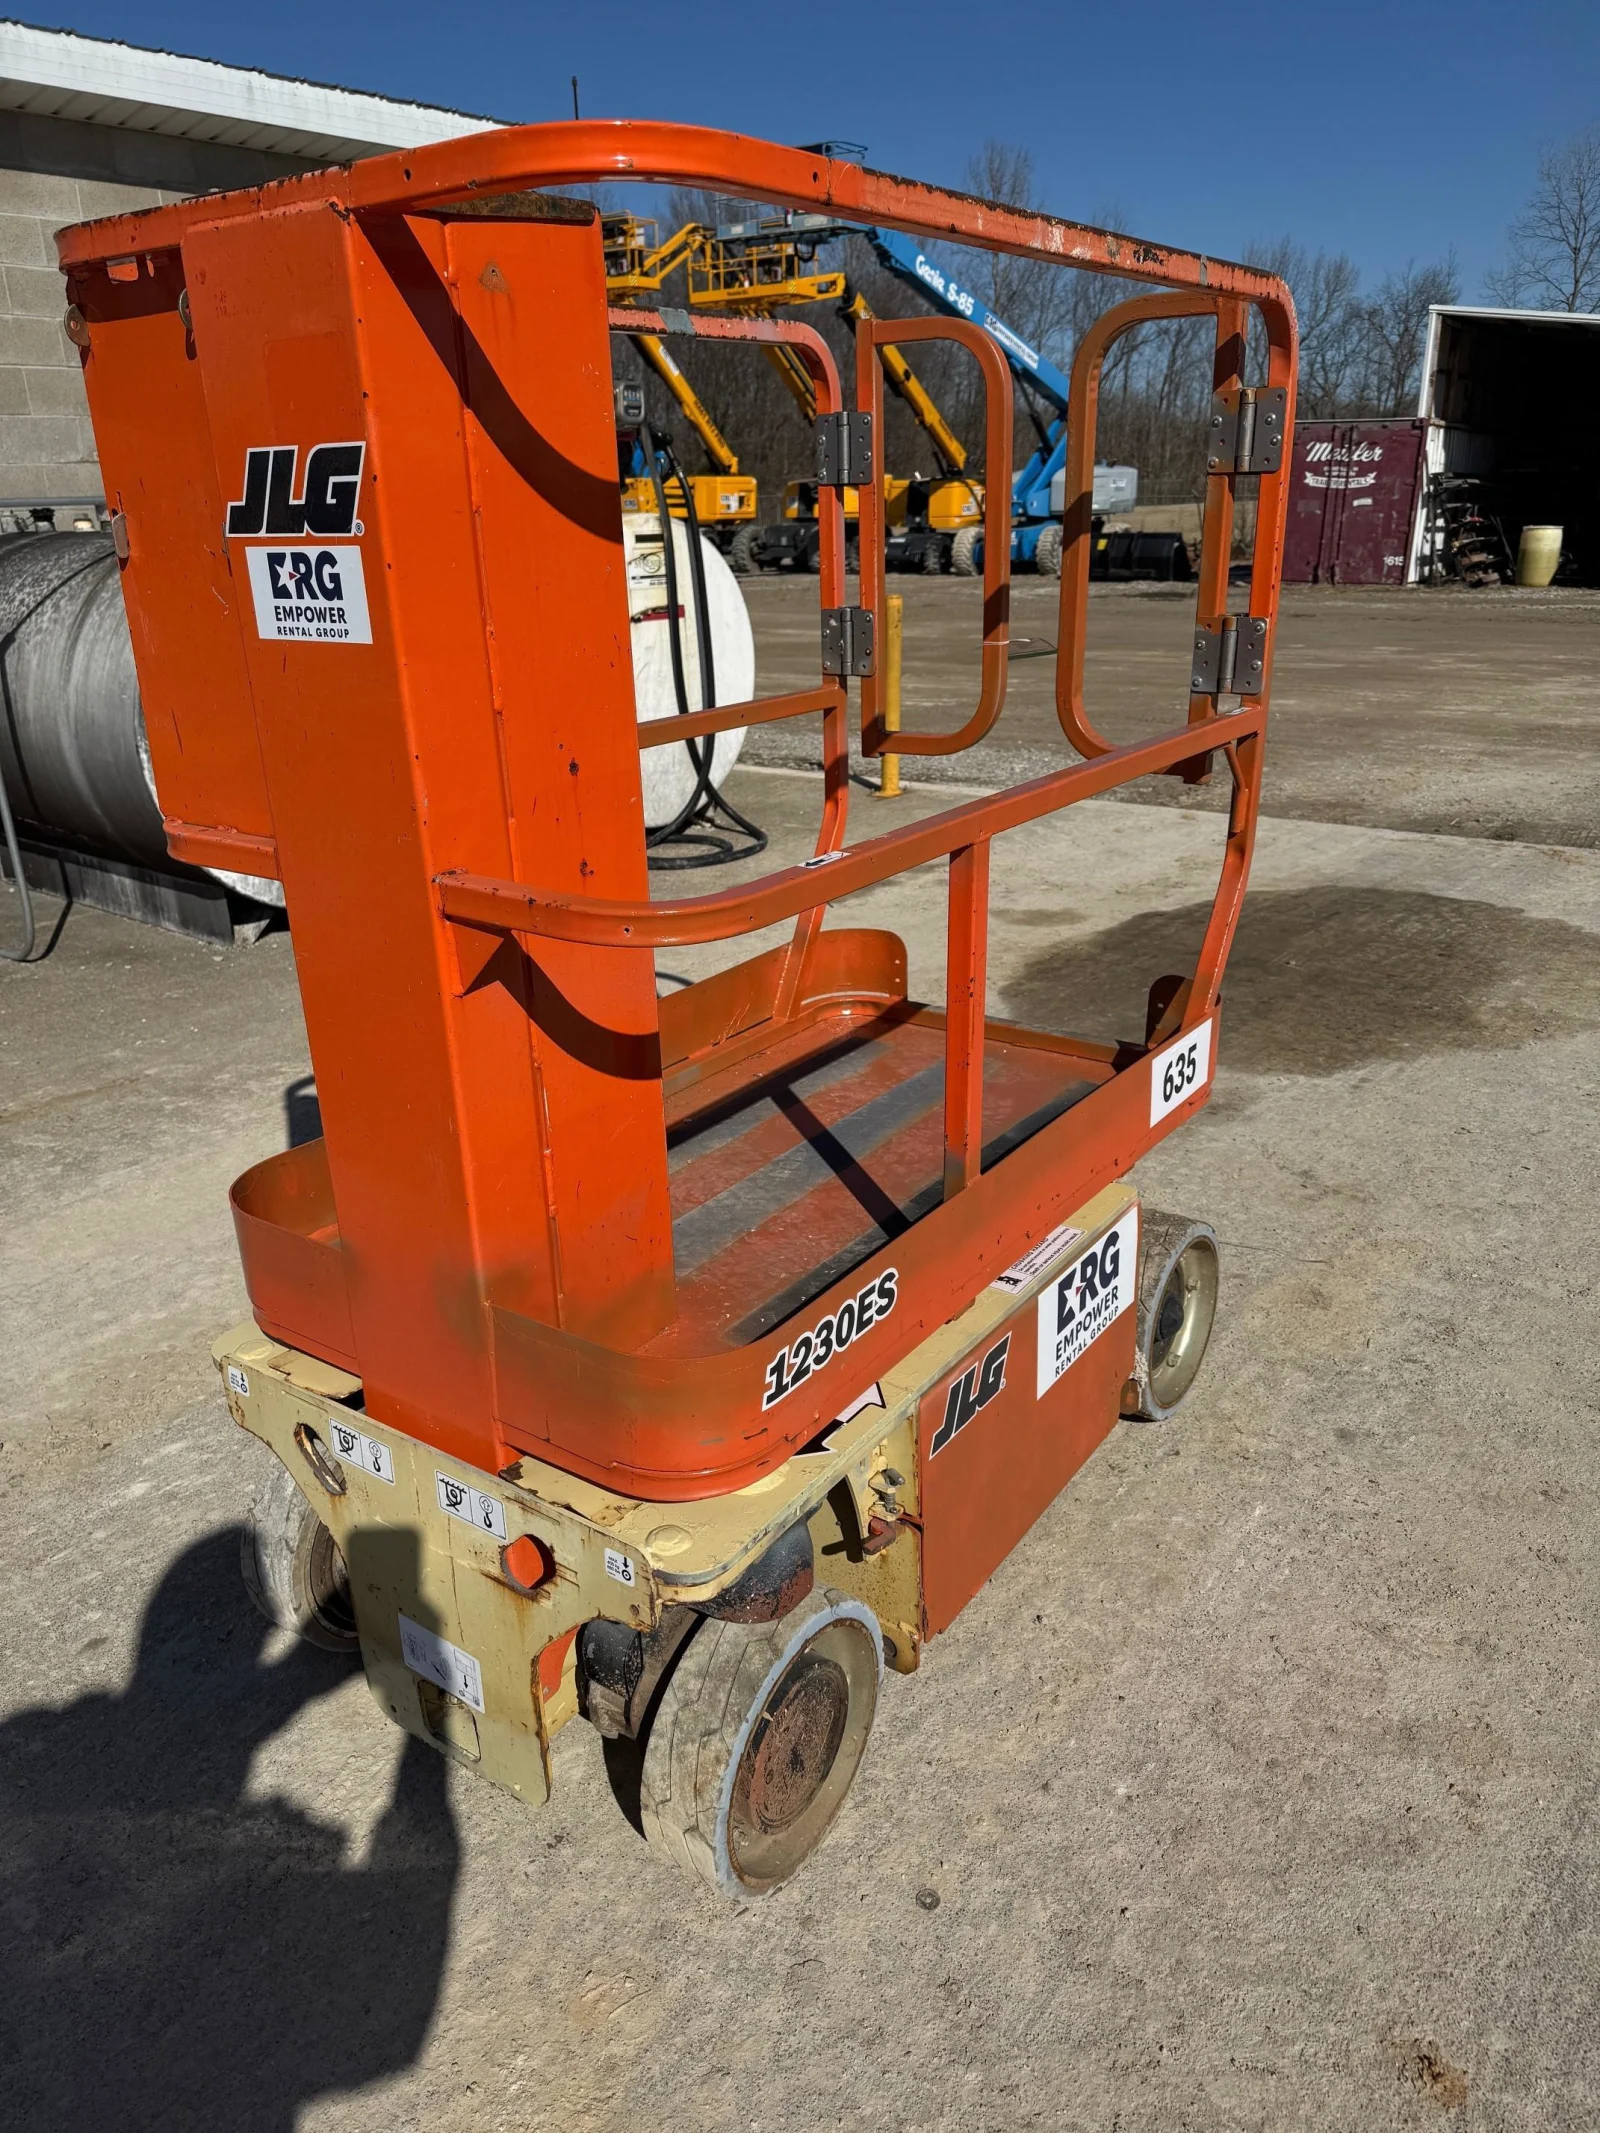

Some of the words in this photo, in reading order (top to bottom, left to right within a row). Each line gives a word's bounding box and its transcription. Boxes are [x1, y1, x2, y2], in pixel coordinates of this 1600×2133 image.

[916, 254, 945, 294] Genie
[947, 283, 975, 316] S-85
[227, 443, 363, 535] JLG
[266, 550, 344, 601] ERG
[274, 605, 347, 624] EMPOWER
[277, 626, 313, 637] RENTAL
[316, 627, 350, 638] GROUP
[1163, 1043, 1197, 1103] 635
[1057, 1230, 1120, 1336] ERG
[765, 1271, 898, 1406] 1230ES
[1055, 1285, 1119, 1362] EMPOWER
[1055, 1337, 1087, 1377] RENTAL
[1091, 1306, 1119, 1340] GROUP
[929, 1335, 1010, 1459] JLG
